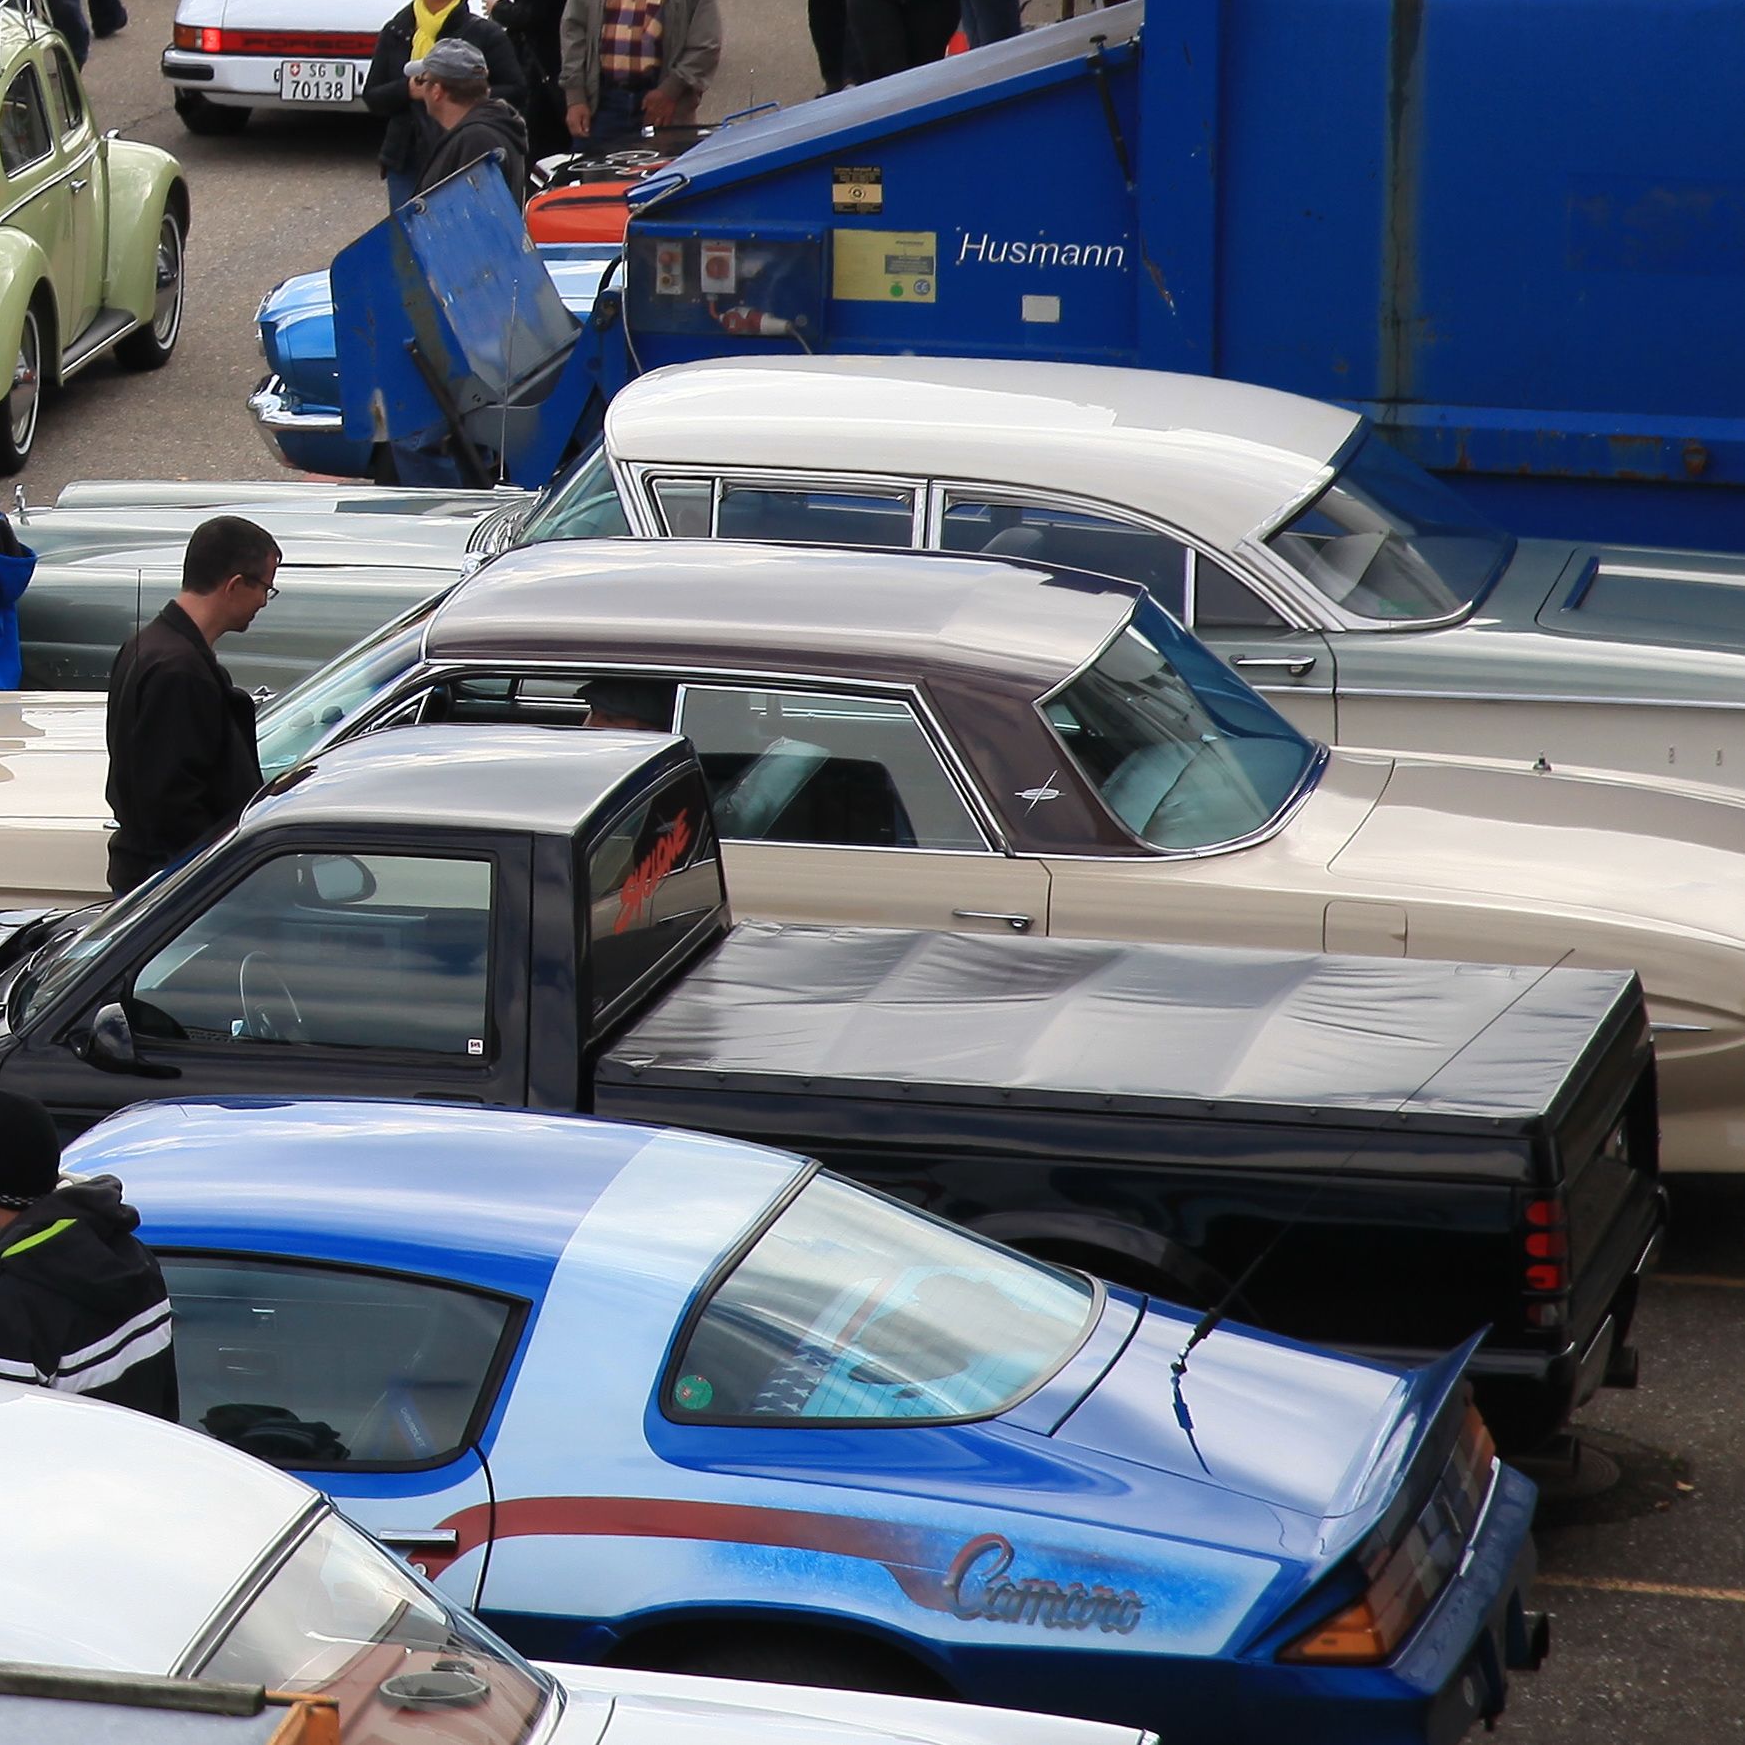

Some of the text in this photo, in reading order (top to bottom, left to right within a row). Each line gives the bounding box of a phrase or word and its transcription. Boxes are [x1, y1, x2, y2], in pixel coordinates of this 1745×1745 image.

[309, 64, 327, 77] SG
[291, 80, 344, 100] 70138
[960, 232, 1125, 268] Husmann
[941, 1531, 1148, 1636] Camaro
